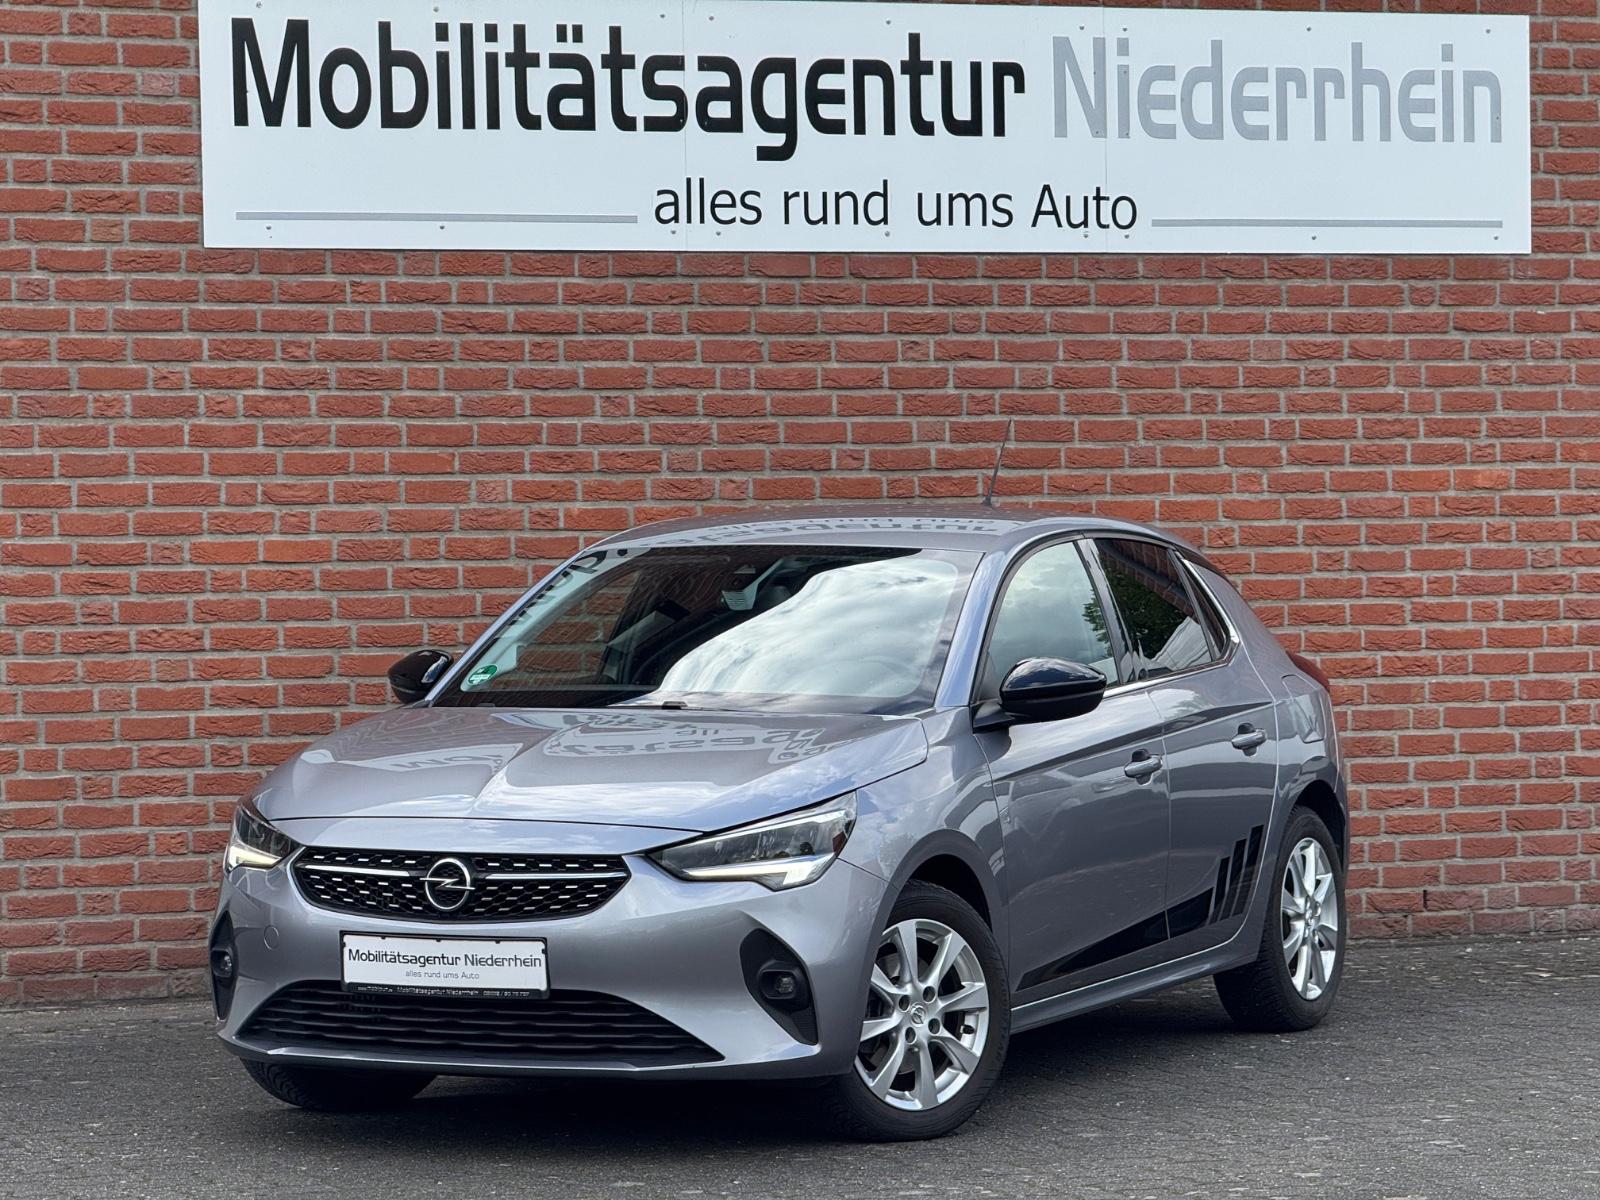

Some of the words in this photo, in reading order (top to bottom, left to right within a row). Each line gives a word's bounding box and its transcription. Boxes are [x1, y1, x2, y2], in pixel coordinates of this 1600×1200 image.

[232, 18, 1025, 161] Mobilitätsagentur
[1053, 36, 1502, 143] Niederrhein
[655, 178, 762, 226] alles
[783, 179, 889, 227] rund
[917, 192, 1014, 228] ums
[1031, 184, 1138, 230] Auto
[348, 949, 461, 968] Mobilitätsagentur
[464, 954, 541, 968] Niederrhein
[405, 970, 422, 978] alles
[424, 970, 441, 979] rund
[443, 972, 459, 980] ums
[461, 972, 480, 980] Auto
